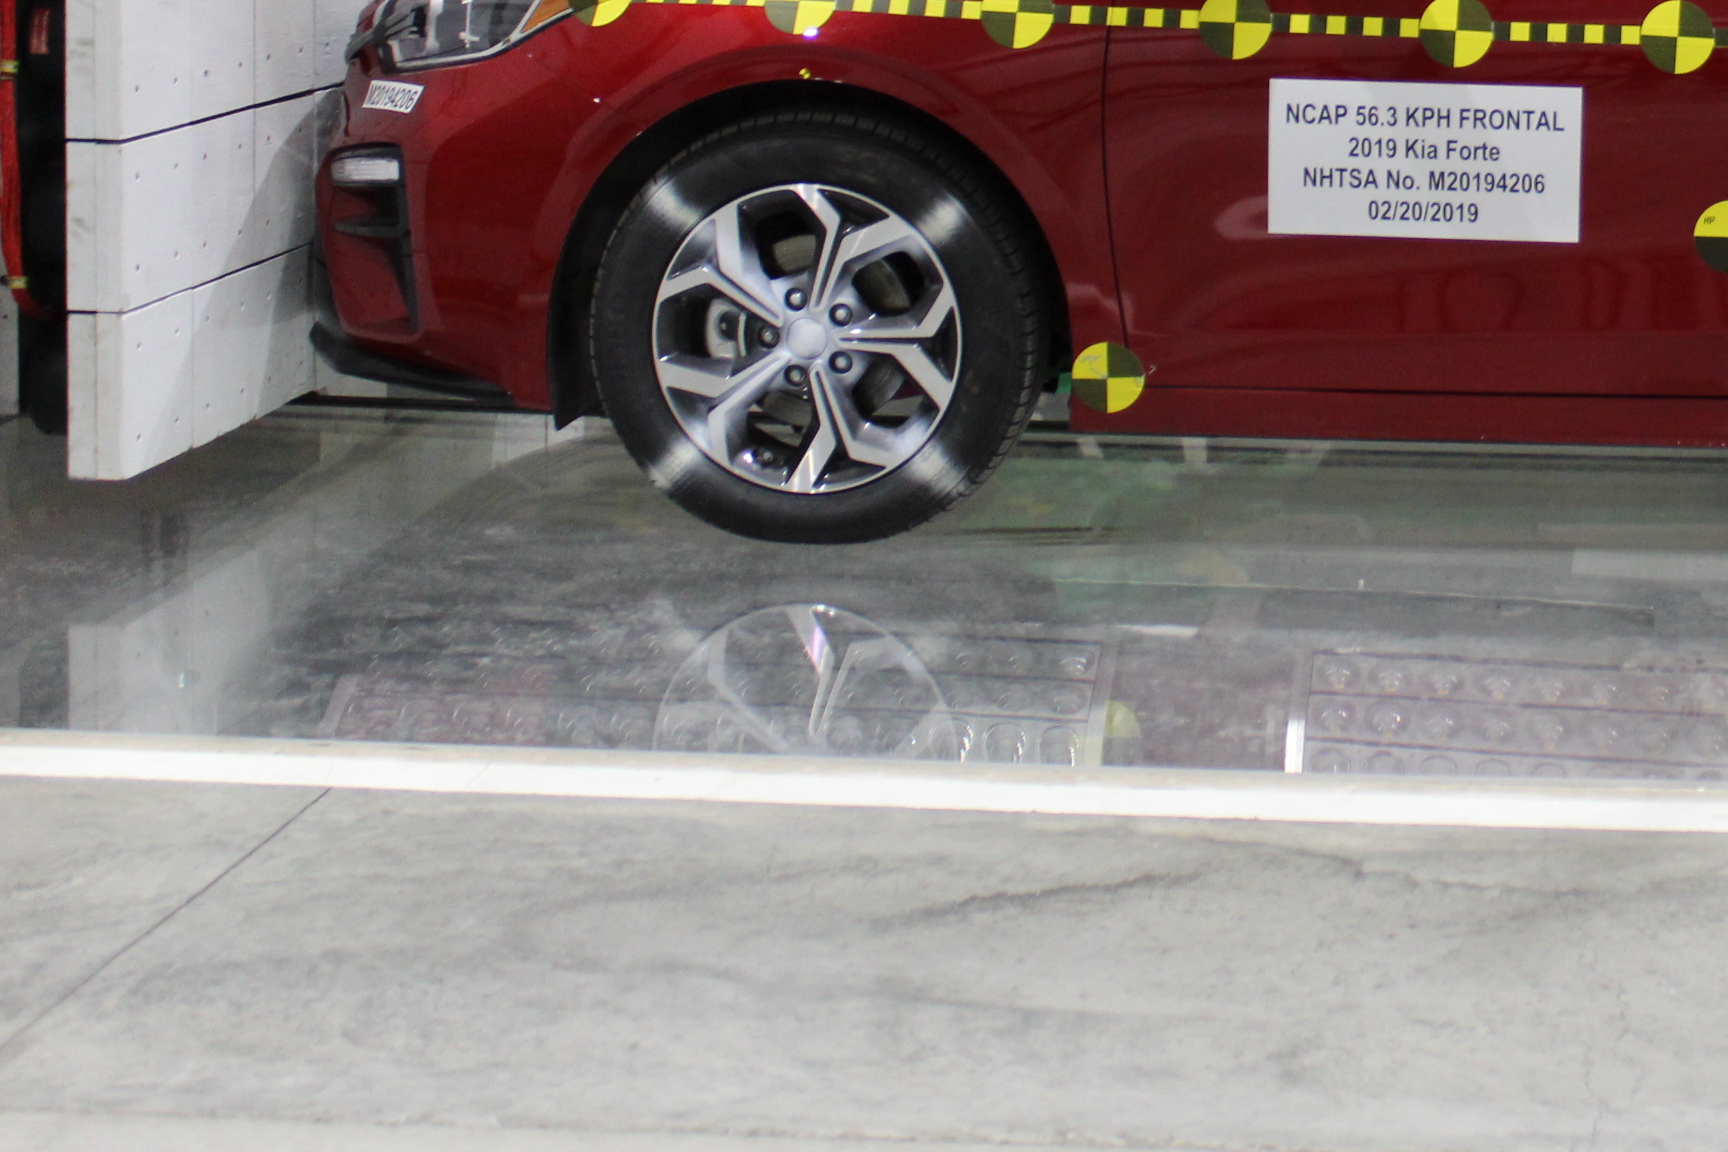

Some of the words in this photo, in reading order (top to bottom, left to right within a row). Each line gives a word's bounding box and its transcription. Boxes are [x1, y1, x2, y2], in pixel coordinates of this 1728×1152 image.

[1286, 104, 1348, 125] NCAP
[1355, 106, 1398, 127] 56.3
[1405, 107, 1451, 129] KPH
[1459, 109, 1565, 132] FRONTAL
[1348, 137, 1397, 159] 2019
[1405, 139, 1438, 160] Kia
[1446, 140, 1501, 162] Forte
[1303, 167, 1379, 189] NHTSA
[1386, 169, 1420, 191] No.
[1428, 171, 1546, 194] M20194206
[1368, 201, 1479, 224] 02/20/2019
